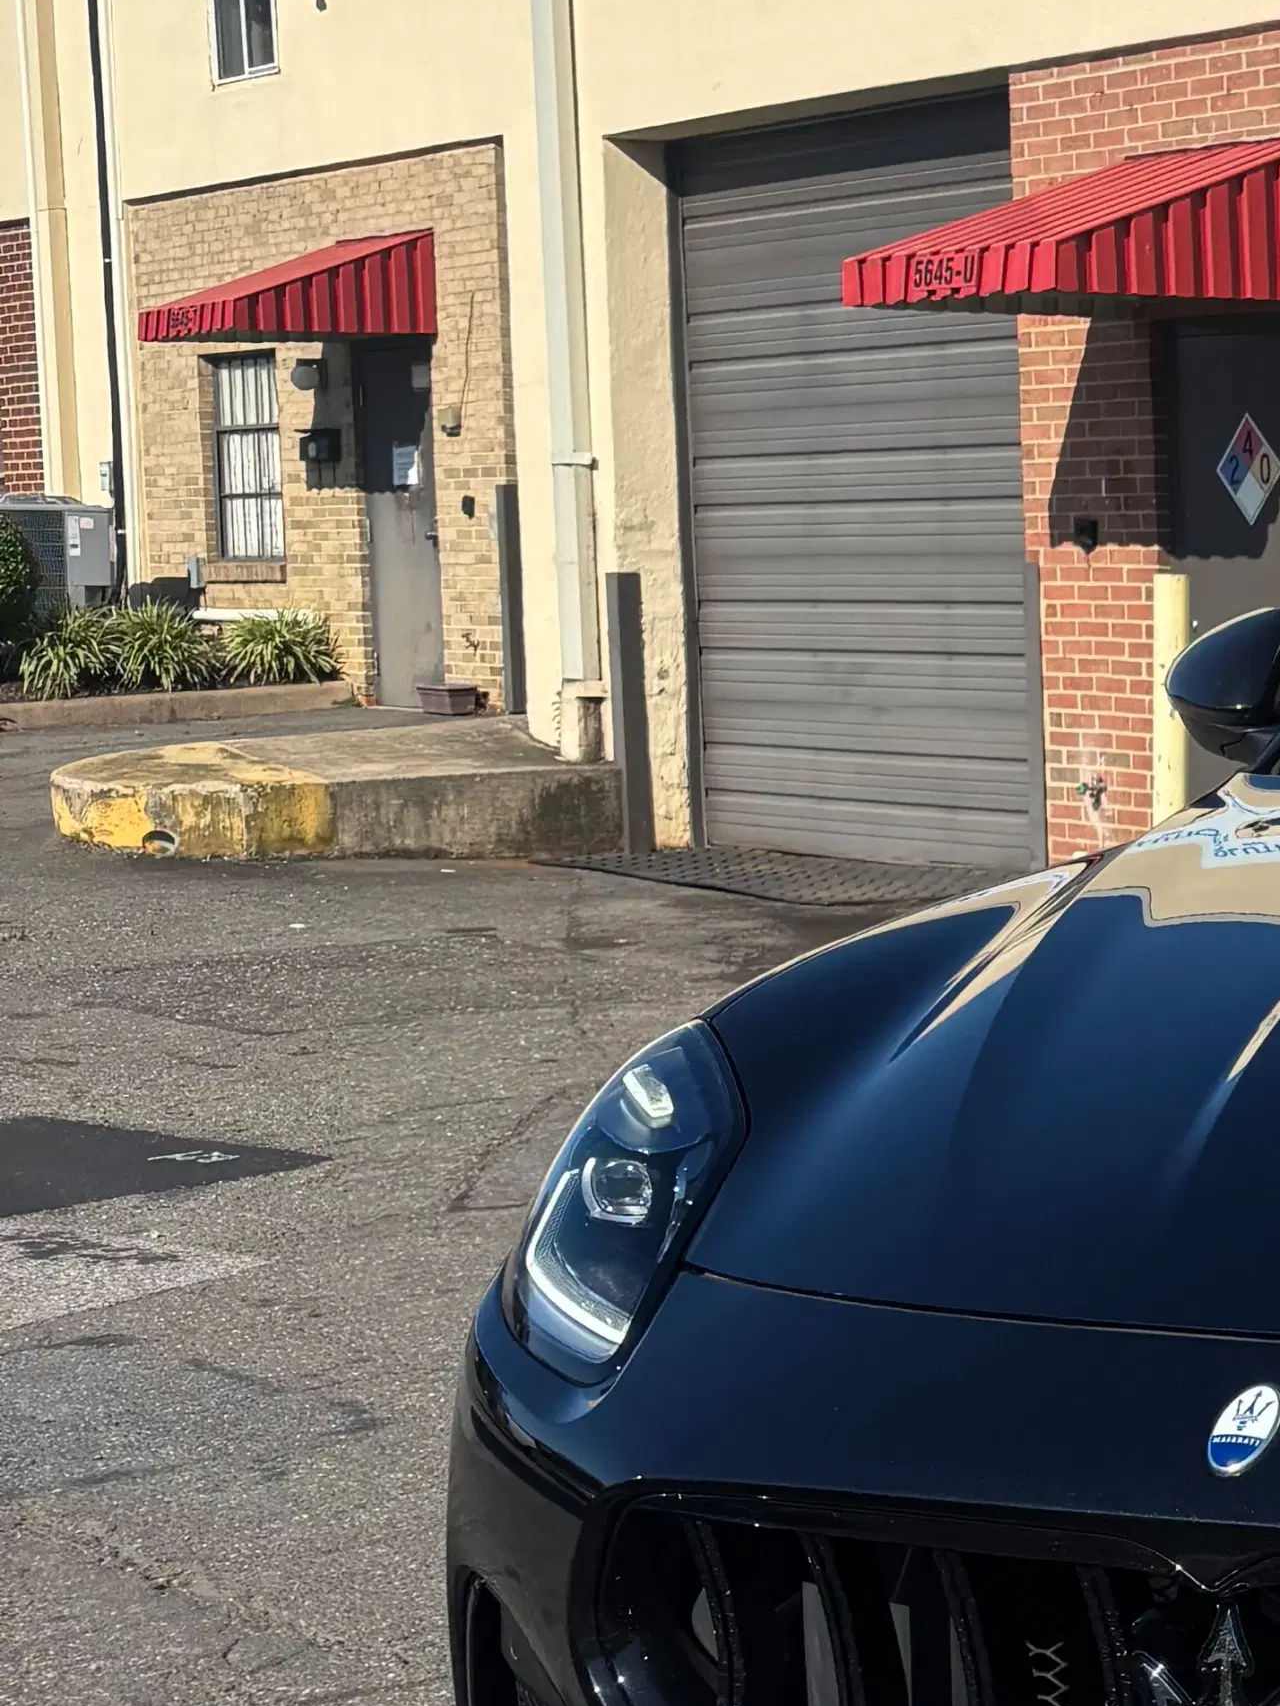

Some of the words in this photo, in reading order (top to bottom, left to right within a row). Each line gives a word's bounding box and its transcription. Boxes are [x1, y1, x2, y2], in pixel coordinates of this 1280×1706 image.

[913, 254, 975, 288] 5645-U
[1242, 430, 1254, 460] 4
[1228, 455, 1241, 486] 2
[1260, 453, 1271, 485] 0
